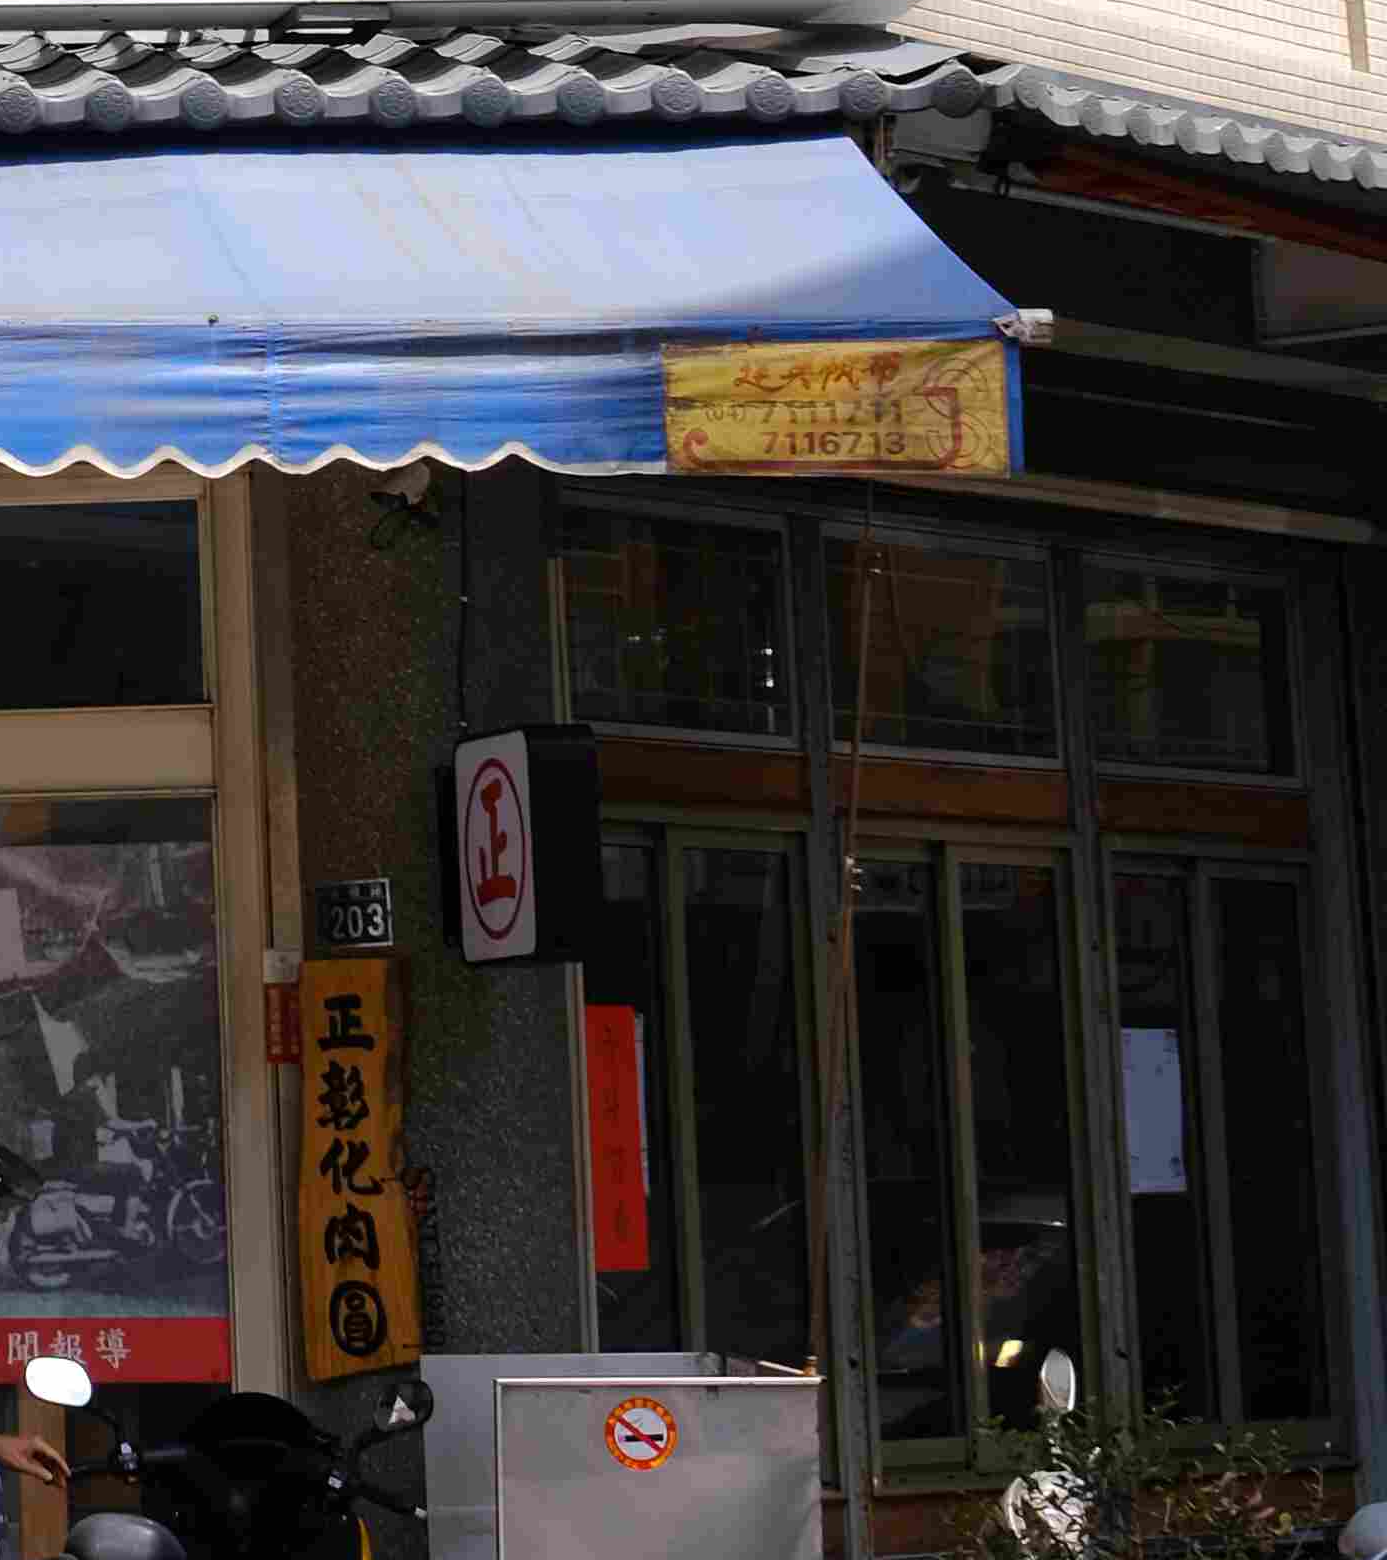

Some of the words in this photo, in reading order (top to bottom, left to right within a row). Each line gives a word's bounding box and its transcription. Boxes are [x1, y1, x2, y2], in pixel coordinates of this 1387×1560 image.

[762, 431, 907, 456] 7116713
[477, 777, 519, 907] 正
[330, 902, 386, 940] 203
[316, 993, 388, 1358] 正彰化肉圓
